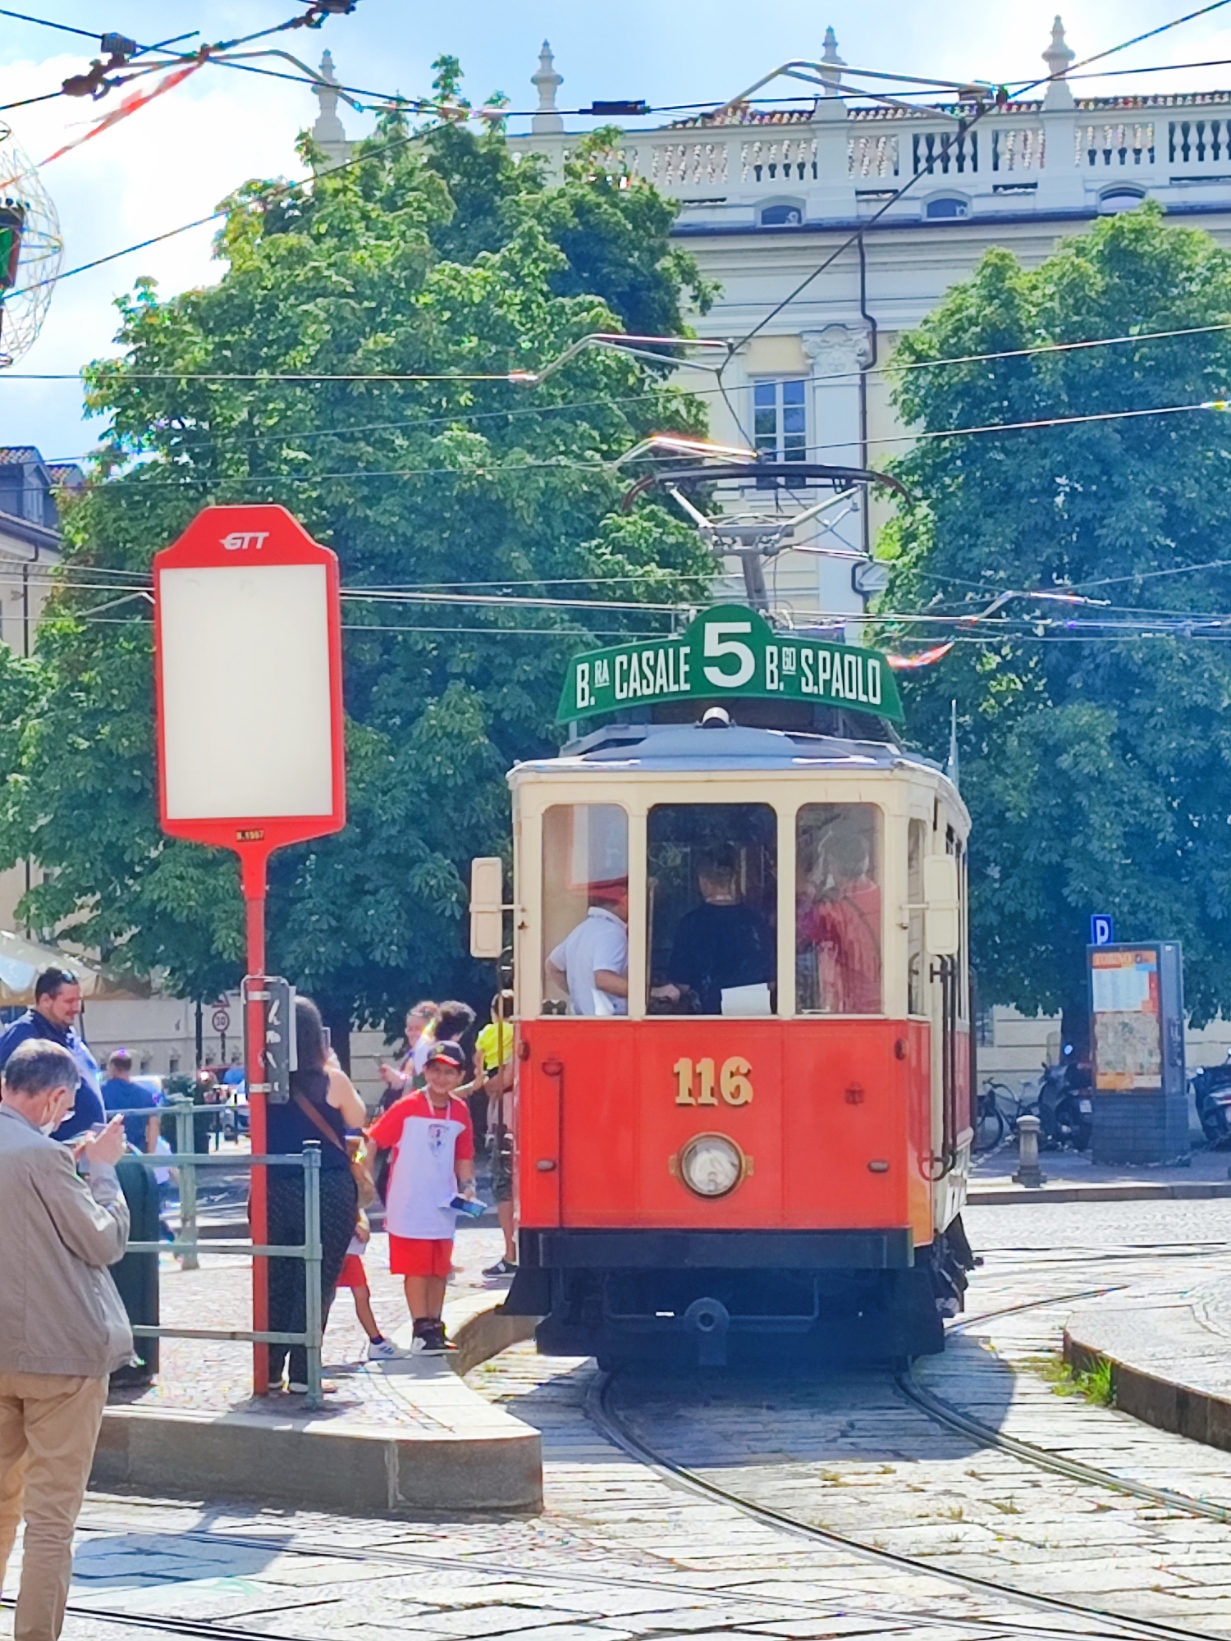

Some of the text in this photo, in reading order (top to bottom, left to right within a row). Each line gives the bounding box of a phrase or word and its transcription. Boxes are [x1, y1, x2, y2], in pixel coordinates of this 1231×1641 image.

[219, 532, 270, 550] GTT
[615, 646, 691, 700] CASALE
[703, 622, 756, 688] 5
[801, 648, 881, 705] S.PAOLO
[1096, 919, 1109, 945] P
[673, 1056, 754, 1107] 116
